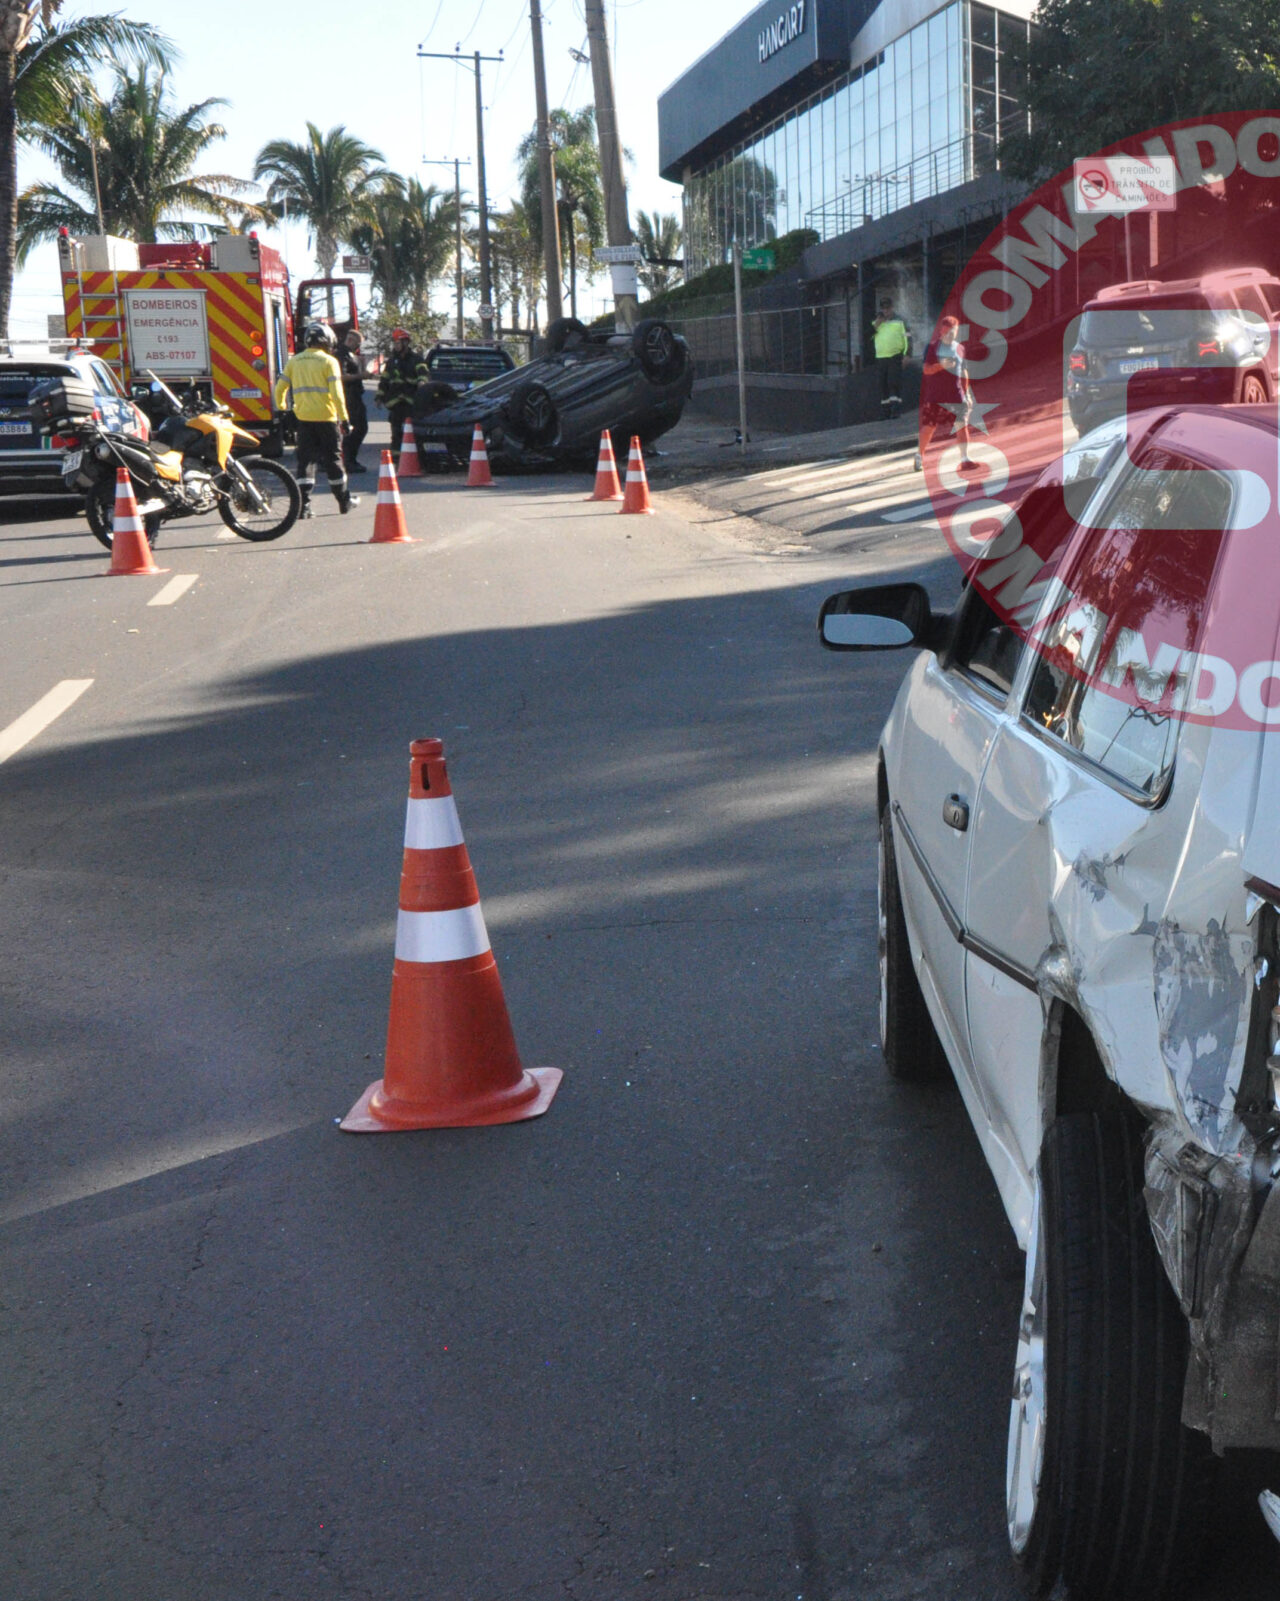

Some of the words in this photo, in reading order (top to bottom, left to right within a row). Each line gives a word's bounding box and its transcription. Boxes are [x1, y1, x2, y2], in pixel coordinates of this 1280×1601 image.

[1119, 166, 1162, 175] PROIBIDO
[1159, 179, 1172, 188] DE
[132, 299, 198, 310] BOMBEIROS
[133, 317, 199, 328] EMERGÊNCIA
[145, 351, 197, 360] ABS-07107
